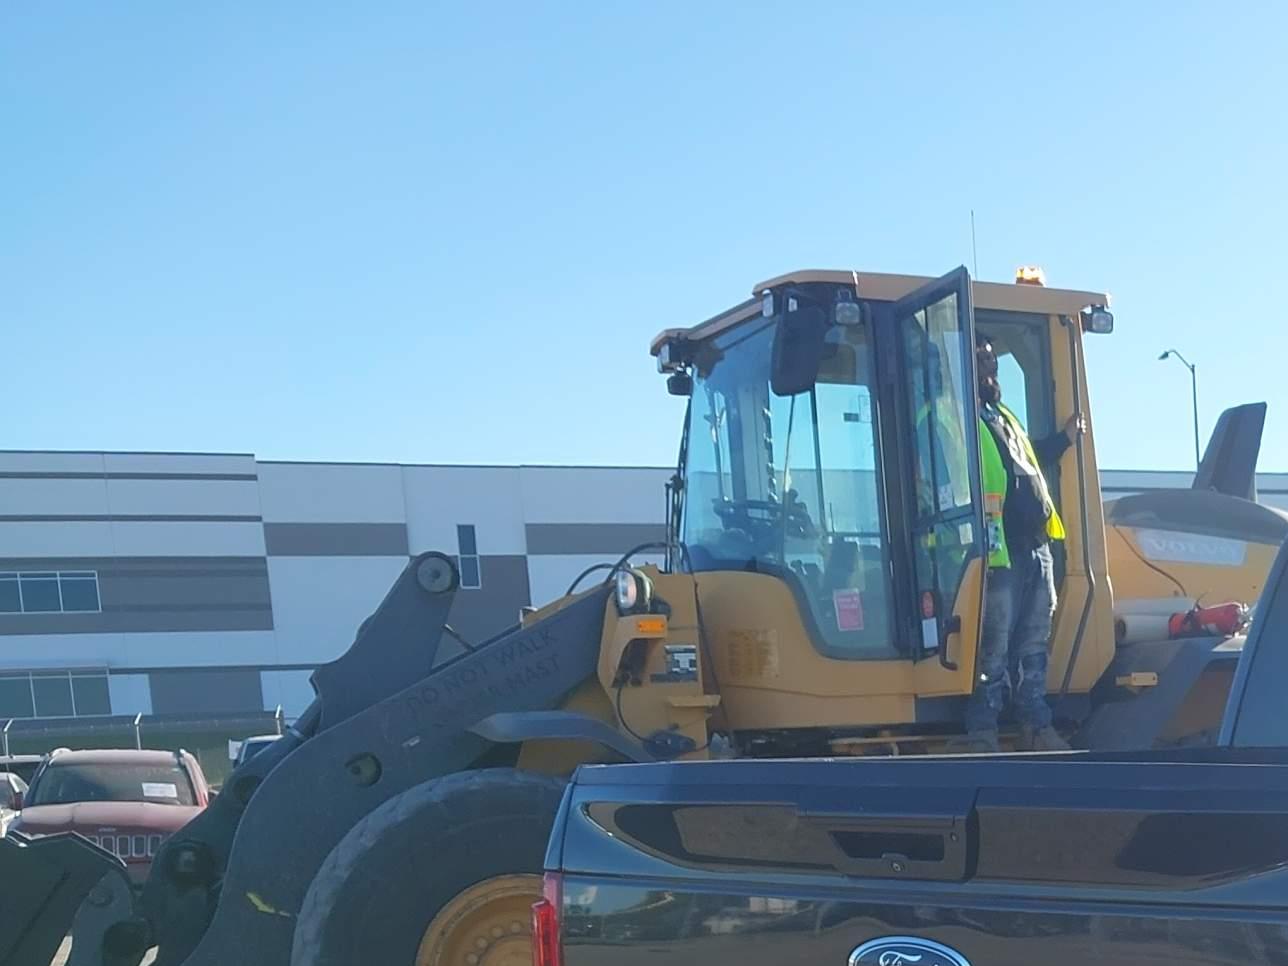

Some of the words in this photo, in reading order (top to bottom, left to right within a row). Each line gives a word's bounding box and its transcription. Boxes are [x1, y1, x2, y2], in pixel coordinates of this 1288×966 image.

[406, 686, 439, 717] DO
[443, 660, 489, 695] NOT
[495, 627, 559, 667] WALK
[505, 654, 560, 690] MAST
